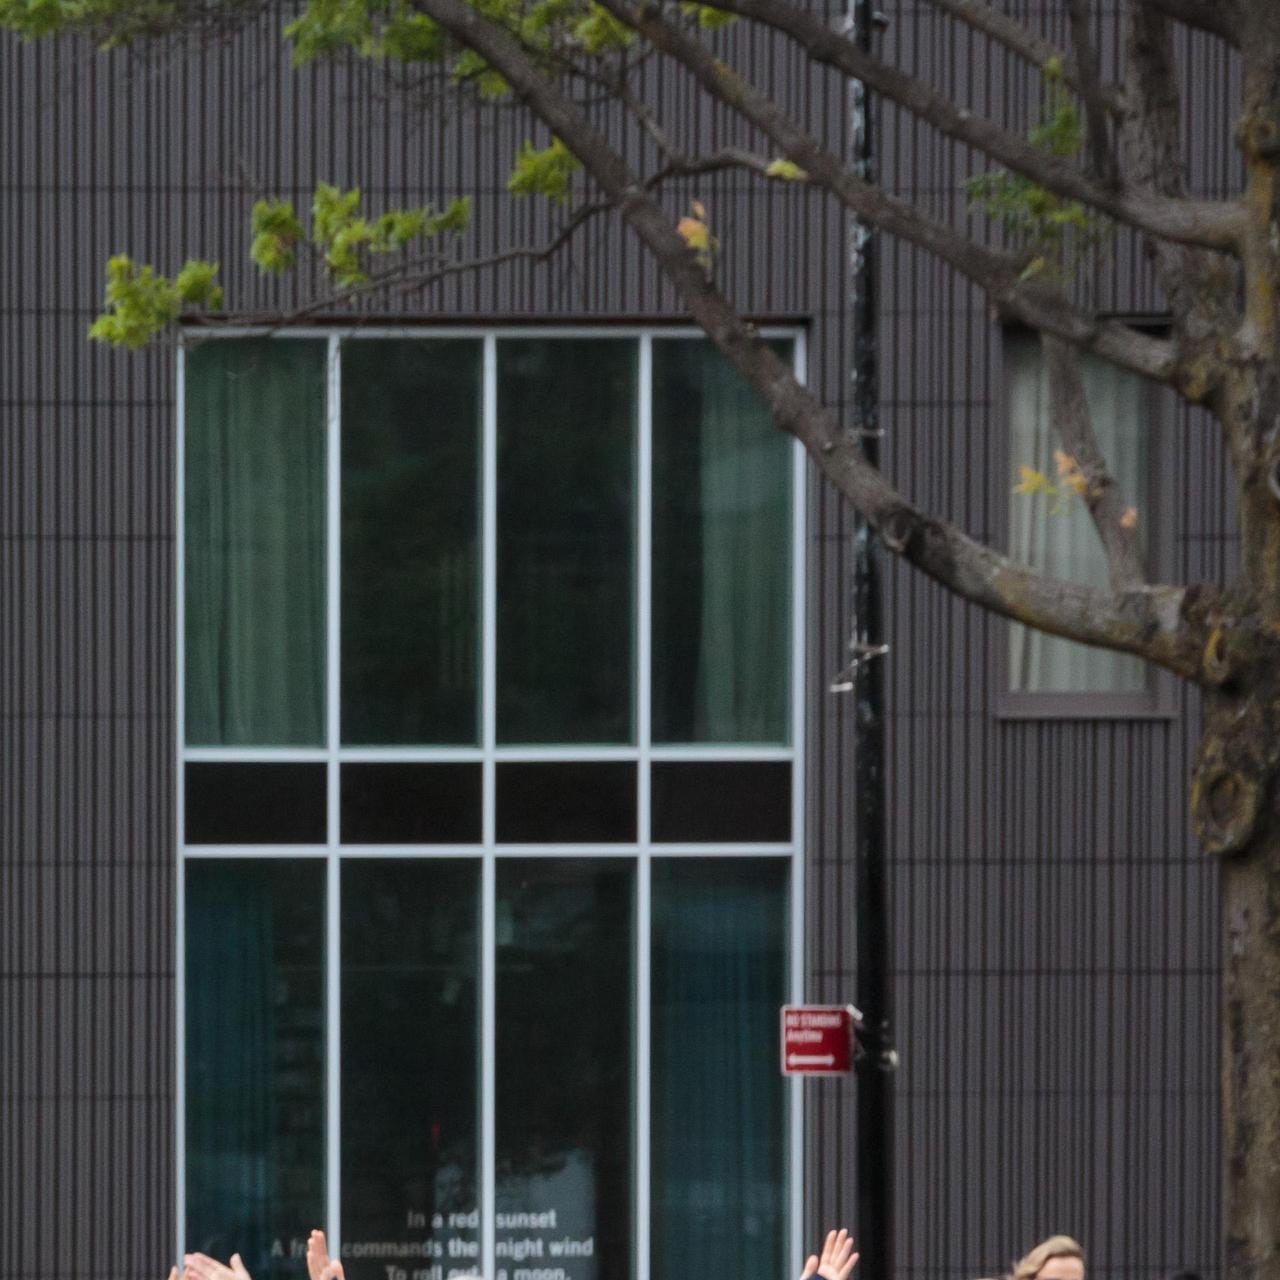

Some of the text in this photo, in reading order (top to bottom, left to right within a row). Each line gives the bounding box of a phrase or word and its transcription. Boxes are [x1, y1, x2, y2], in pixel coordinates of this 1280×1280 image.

[407, 1209, 557, 1229] In a red sunset
[342, 1238, 443, 1258] commands
[448, 1237, 480, 1257] the
[495, 1237, 544, 1262] night
[548, 1237, 594, 1257] wind
